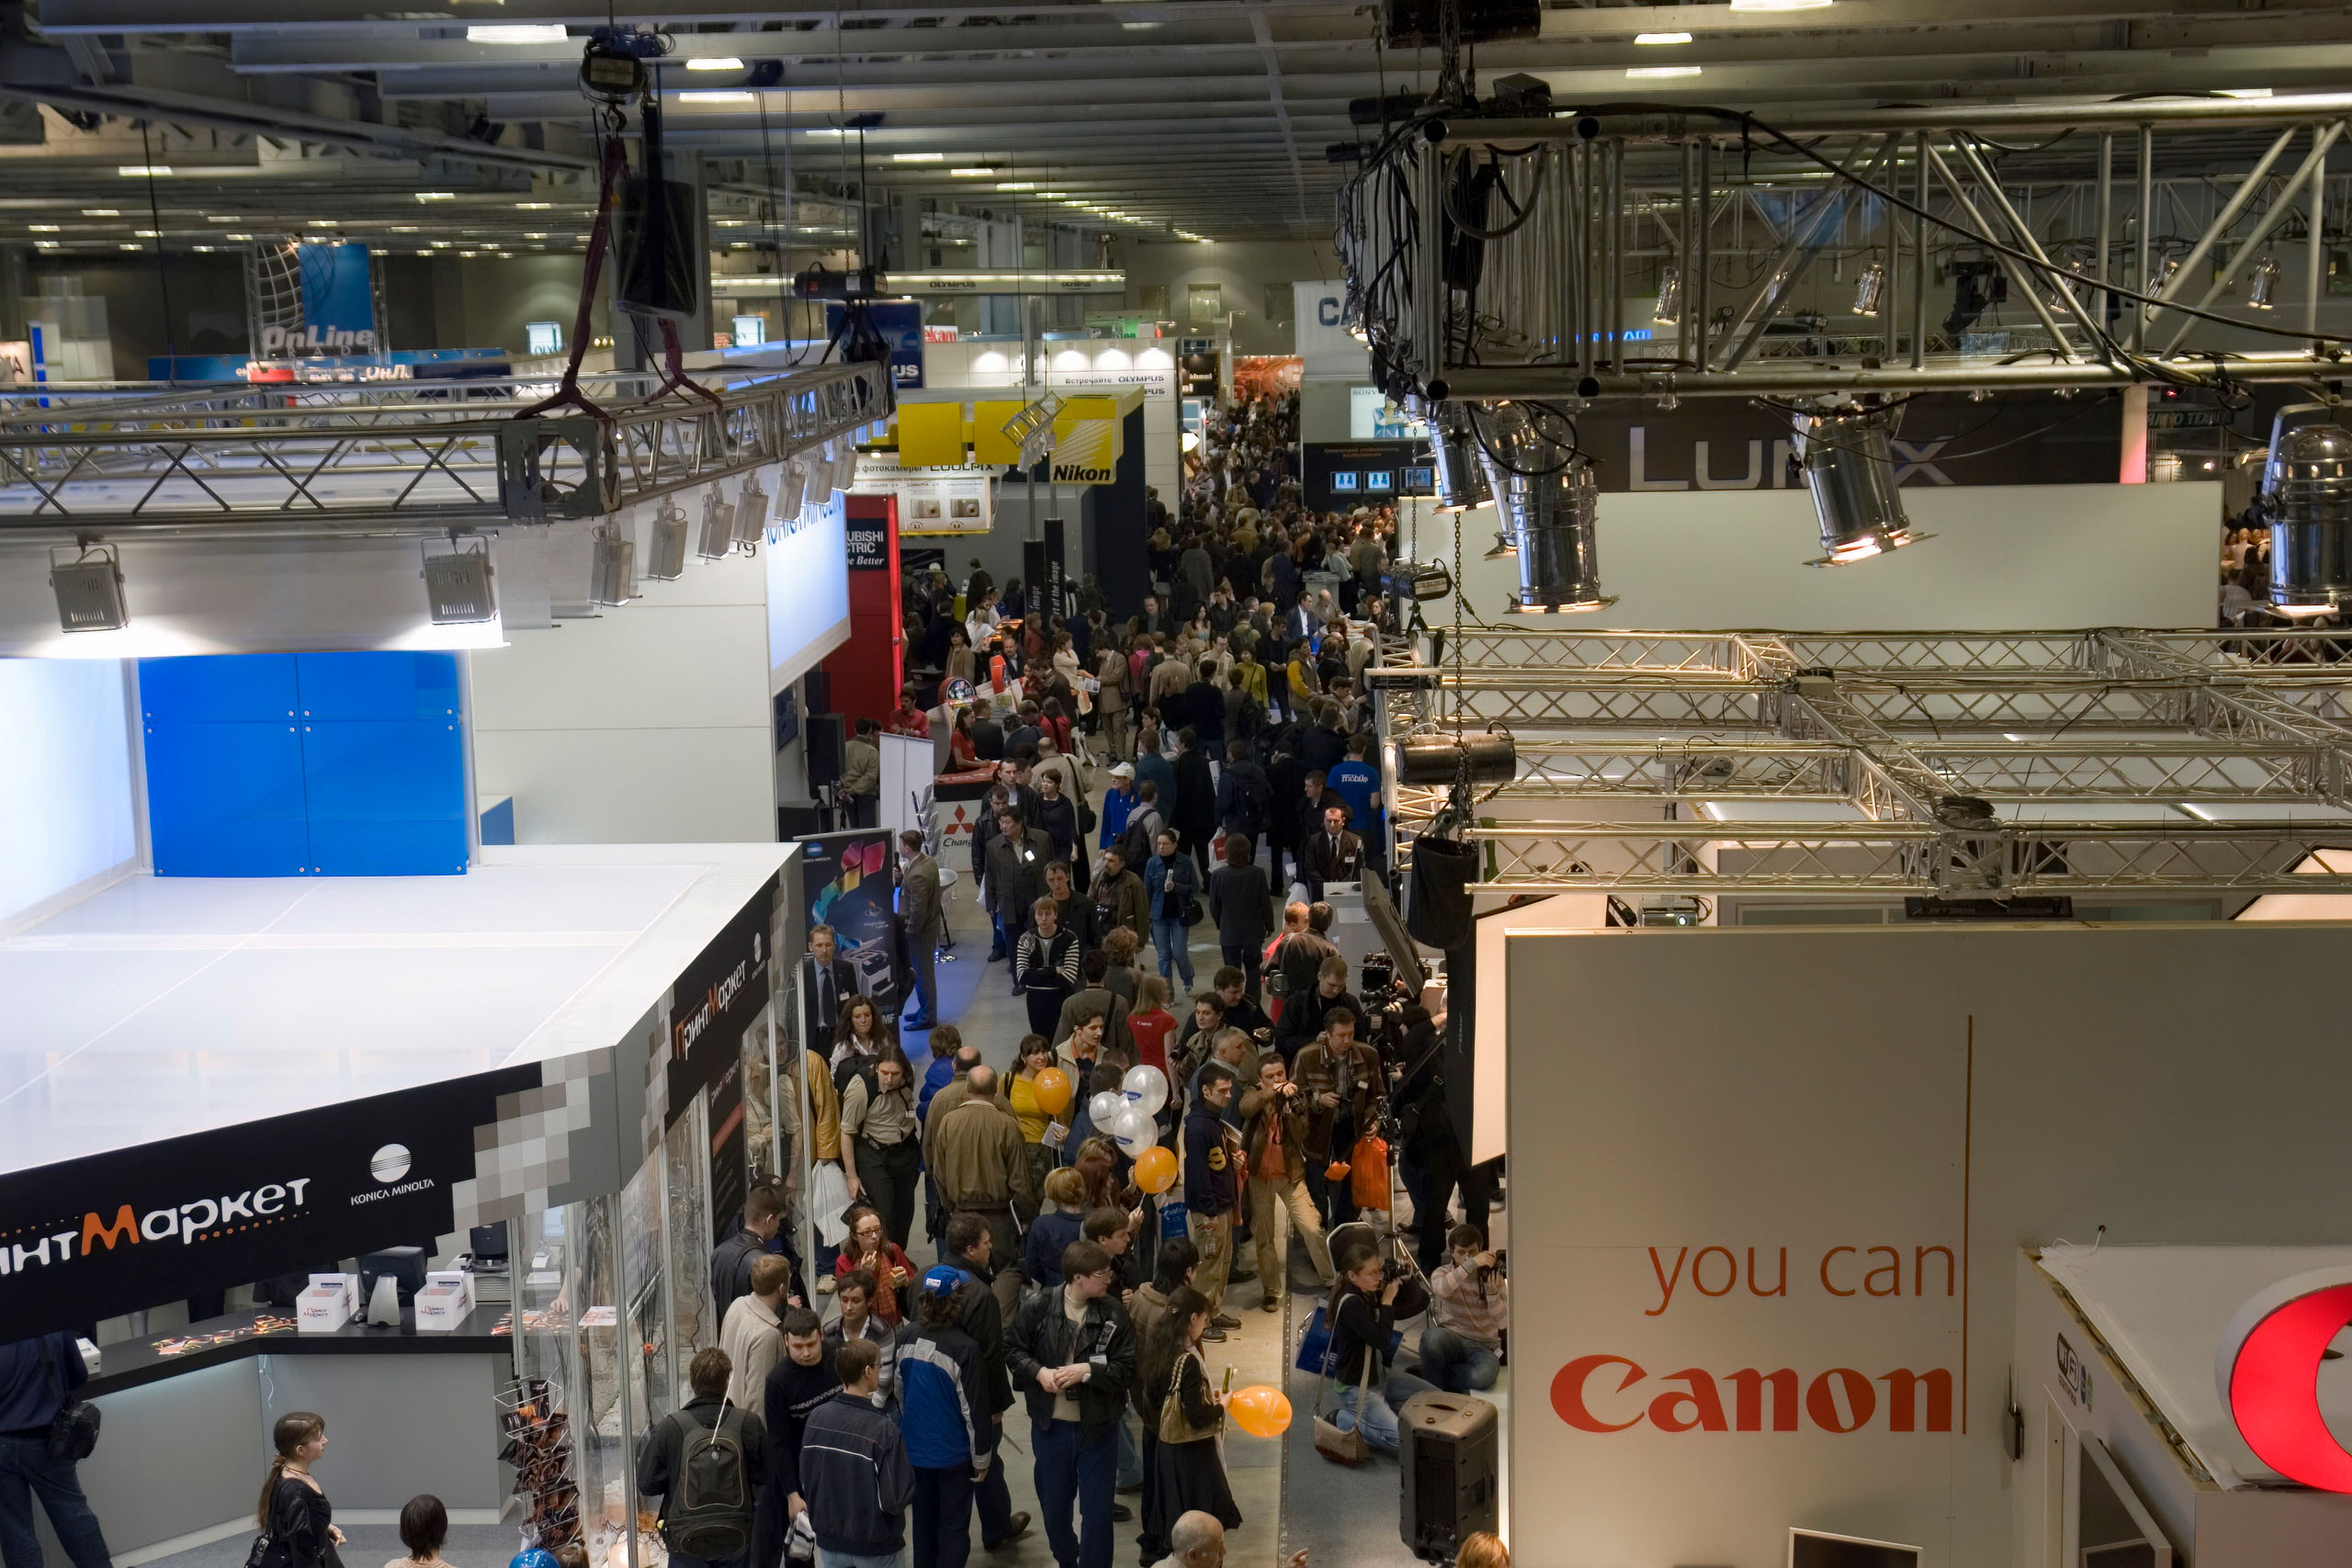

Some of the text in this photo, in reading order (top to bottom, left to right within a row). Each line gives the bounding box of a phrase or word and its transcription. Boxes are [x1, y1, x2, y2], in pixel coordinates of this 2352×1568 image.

[262, 324, 374, 349] OnLine
[1053, 465, 1111, 482] Nikon
[856, 556, 884, 566] Better
[1049, 560, 1060, 583] image
[350, 1179, 435, 1206] KONICA MINOLTA
[1645, 1246, 1954, 1316] you can
[1550, 1354, 1952, 1434] Canon
